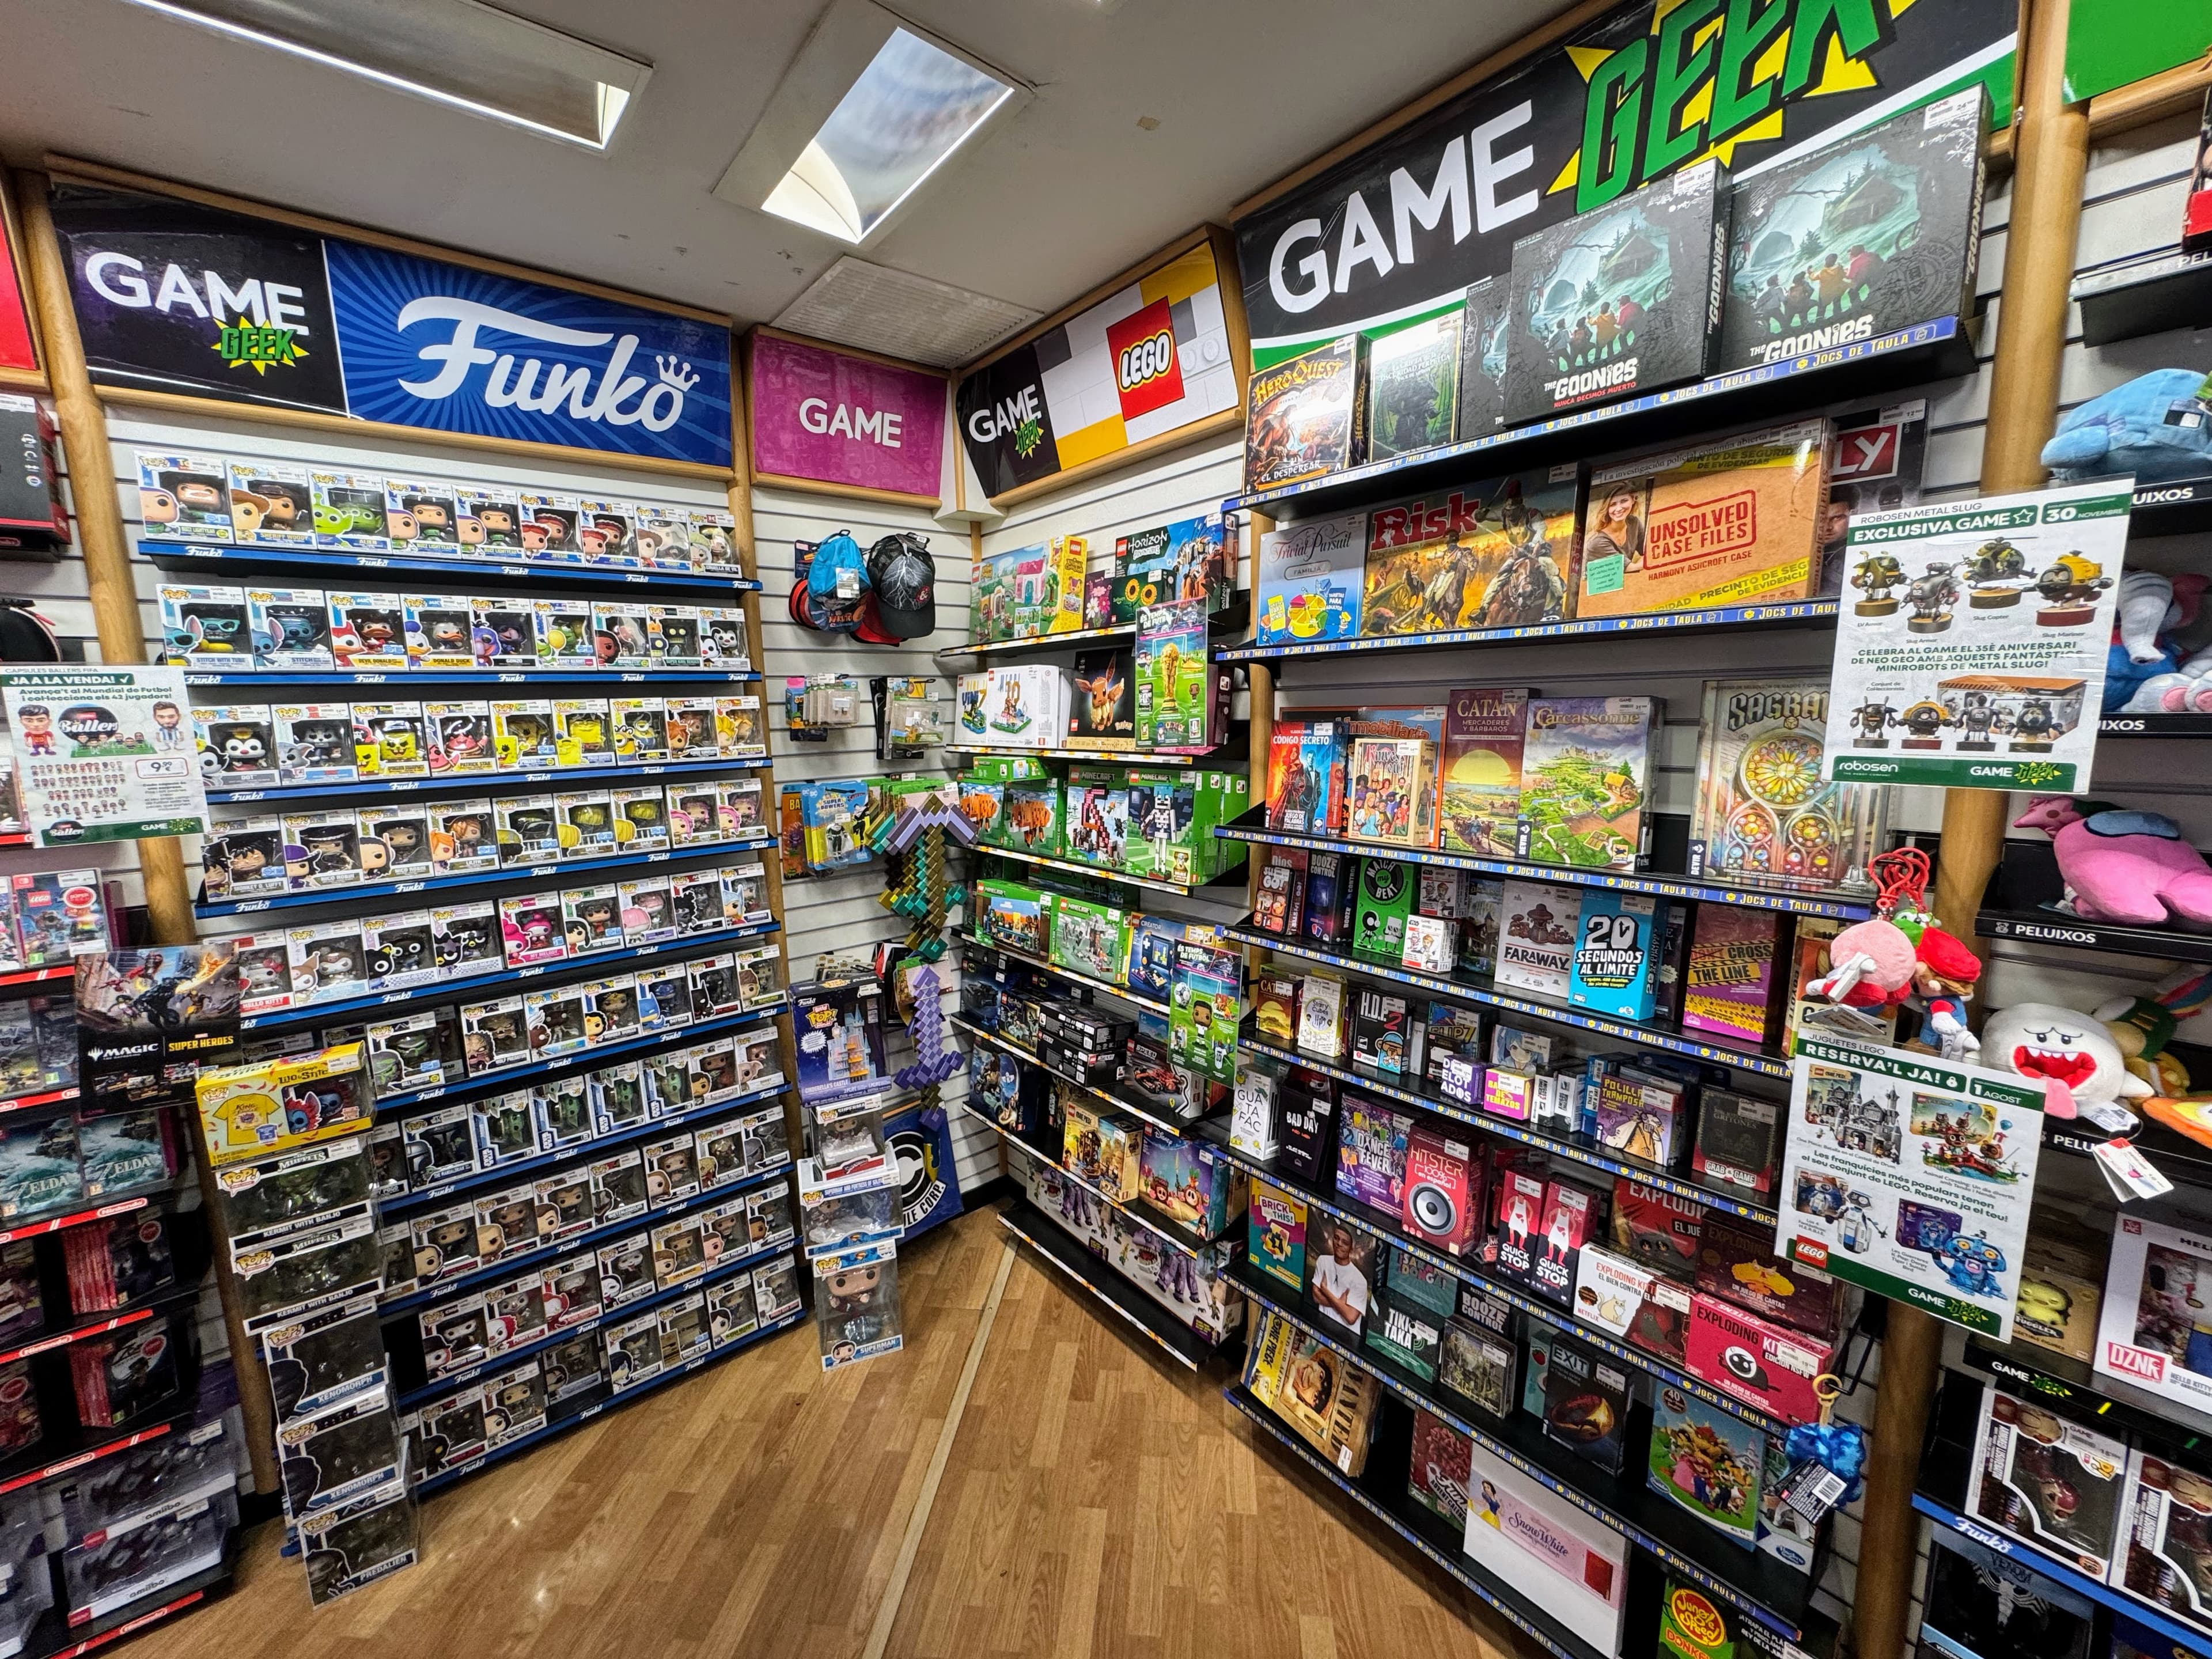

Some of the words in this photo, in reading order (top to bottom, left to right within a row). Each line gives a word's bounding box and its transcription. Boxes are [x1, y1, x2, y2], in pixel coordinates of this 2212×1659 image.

[1268, 101, 1539, 314] GAME
[85, 252, 310, 336] GAME
[219, 327, 295, 359] GEEK
[1750, 344, 1765, 357] THE
[1763, 314, 1873, 362] GOONIES
[1813, 351, 1843, 366] JOCS
[1848, 345, 1864, 358] DE
[1870, 334, 1908, 354] TAULA
[398, 297, 685, 431] Funko
[1120, 331, 1171, 391] LEGO
[1544, 381, 1556, 392] THE
[1554, 358, 1638, 402] GOONIES
[1554, 399, 1574, 408] NUNCA
[1576, 391, 1606, 403] DECIMOS
[1608, 382, 1637, 395] MUERTO
[969, 384, 1041, 442] GAME
[800, 399, 902, 448] GAME
[1015, 415, 1041, 454] GEEK
[1603, 474, 1615, 482] La
[1616, 460, 1664, 480] investigación
[1667, 452, 1692, 467] policial
[1737, 432, 1767, 448] abierta
[1261, 471, 1270, 482] EL
[2132, 487, 2193, 505] UIXOS
[1369, 491, 1484, 552] Risk
[1650, 501, 1748, 544] UNSOLVED
[1861, 512, 1911, 524] ROBOSEN
[1914, 507, 1949, 519] METAL
[1952, 503, 1982, 512] SLUG
[2046, 507, 2075, 521] 30
[2078, 509, 2123, 518] NOVEMBRE
[1853, 521, 1954, 541] EXCLUSIVA
[1956, 512, 2010, 530] GAME
[185, 546, 224, 557] Funko
[1268, 540, 1308, 562] Trivial
[1309, 523, 1351, 558] Pursuit
[1652, 538, 1692, 560] CASE
[1700, 524, 1747, 548] FILES
[1294, 565, 1321, 576] FAMILIA
[1648, 568, 1684, 581] HARMONY
[1687, 556, 1728, 574] ASHCROFT
[1730, 550, 1752, 562] CASE
[1998, 642, 2076, 650] ANIVERSARI
[1876, 663, 1947, 672] MINIROBOTS
[2010, 660, 2048, 668] SLUG!
[185, 675, 221, 684] Funko
[1456, 698, 1517, 717] CATAN
[1536, 709, 1640, 726] Carcassonne
[1729, 691, 1830, 732] SAGRA
[59, 720, 117, 733] Ballers
[1463, 718, 1510, 728] MERCADERES
[1273, 734, 1297, 745] CÓDIGO
[1300, 736, 1329, 745] SECRETO
[1081, 771, 1115, 782] MINECRAFT
[1141, 771, 1171, 782] MINECRAFT
[1839, 762, 1898, 772] robosen
[1970, 767, 2012, 777] GAME
[2018, 764, 2056, 780] GEEK
[1376, 885, 1399, 899] BEAT
[1740, 893, 1766, 906] JOCS
[1771, 899, 1783, 908] DE
[1789, 899, 1822, 913] TAULA
[1585, 915, 1639, 950] 20
[2015, 925, 2096, 944] PELUIXOS
[1575, 950, 1644, 964] SEGUNDOS
[1728, 945, 1772, 959] CROSS
[1580, 964, 1593, 974] AL
[1597, 962, 1637, 975] LÍMITE
[1694, 968, 1722, 981] THE
[1725, 964, 1751, 979] LINE
[242, 1001, 261, 1009] HELLO
[262, 997, 283, 1006] KITTY
[103, 1043, 158, 1056] MAGIC
[169, 1039, 198, 1052] SUPER
[201, 1037, 233, 1047] HEROES
[1809, 1034, 1857, 1050] JUGUETES
[1859, 1044, 1885, 1056] LEGO
[1907, 1069, 1940, 1084] JA!
[1238, 1089, 1263, 1104] GUA
[1974, 1084, 1982, 1094] 1
[1983, 1090, 2021, 1104] AGOST
[1245, 1103, 1259, 1116] TA
[1238, 1112, 1261, 1133] FAC
[1286, 1111, 1302, 1127] BAD
[1303, 1116, 1319, 1134] DAY
[96, 1158, 152, 1180] ZELDA
[1358, 1150, 1391, 1174] FEVER
[1410, 1147, 1463, 1178] HITSTER
[221, 1169, 258, 1183] POP!
[1814, 1150, 1828, 1160] Les
[1911, 1179, 1959, 1198] populars
[1961, 1194, 1994, 1209] tenen
[1810, 1157, 1828, 1166] seu
[1829, 1162, 1867, 1179] conjunt
[1868, 1174, 1881, 1184] de
[1883, 1178, 1911, 1192] LEGO.
[1915, 1189, 1956, 1206] Reserva
[1959, 1202, 1971, 1211] ja
[1973, 1205, 1983, 1215] el
[1983, 1209, 2008, 1222] teu!
[1262, 1199, 1289, 1214] BRICK
[263, 1225, 293, 1237] KERMIT
[294, 1219, 315, 1229] WITH
[316, 1211, 340, 1222] BANJO
[1272, 1211, 1294, 1224] THIS!
[1797, 1241, 1826, 1259] LEGO
[1536, 1267, 1568, 1287] STOP
[1539, 1257, 1569, 1277] QUICK
[1908, 1287, 1945, 1308] GAME
[1697, 1306, 1758, 1345] EXPLODING
[860, 1340, 898, 1354] SUPERMAN
[1554, 1348, 1589, 1374] EXIT
[1991, 1361, 2029, 1381] GAME
[318, 1376, 373, 1404] XENOMORPH
[1954, 1516, 2012, 1554] Funko
